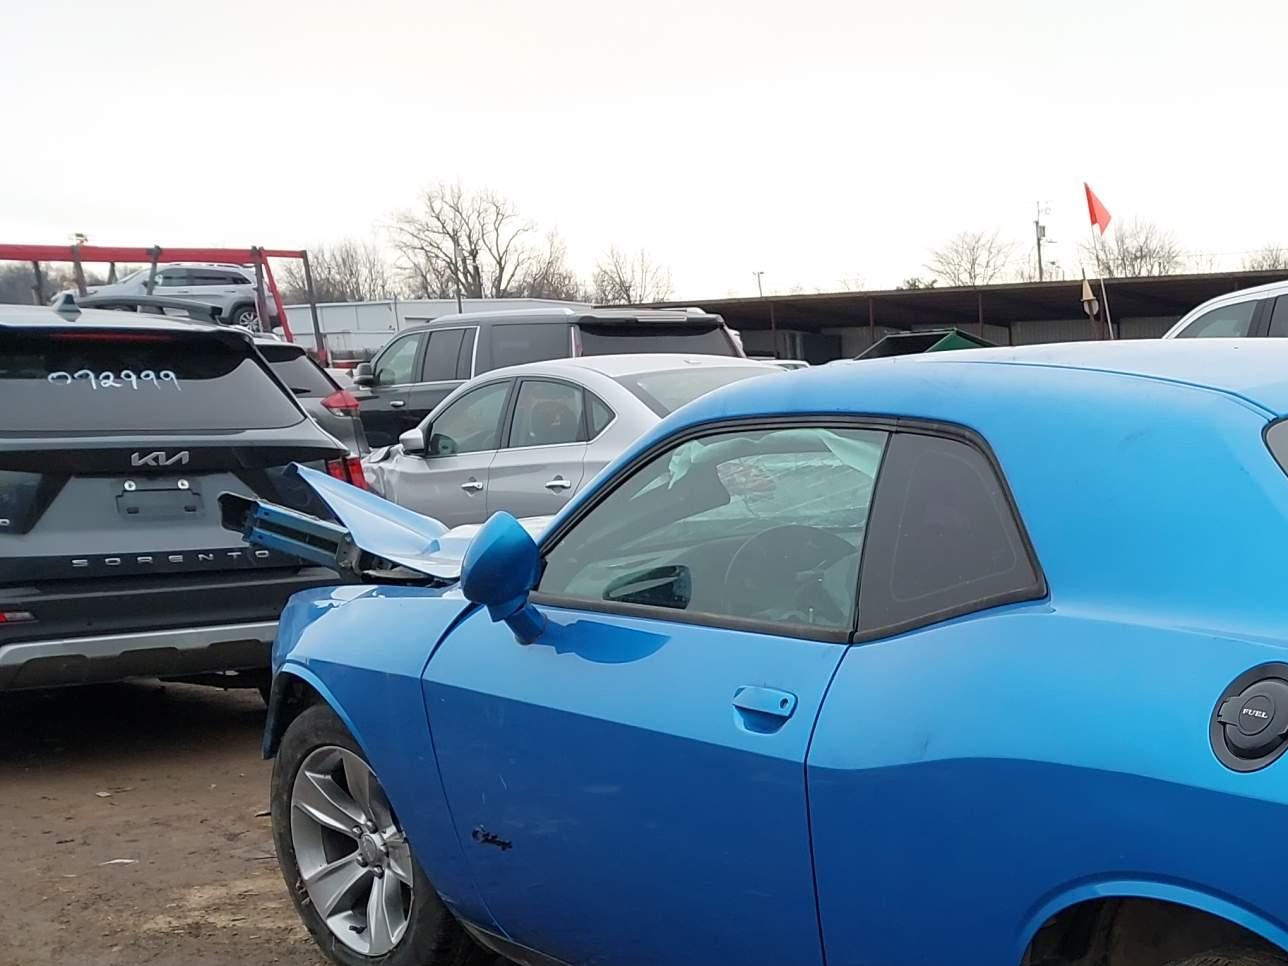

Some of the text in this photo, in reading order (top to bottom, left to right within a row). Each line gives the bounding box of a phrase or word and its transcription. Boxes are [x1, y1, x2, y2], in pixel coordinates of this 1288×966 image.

[48, 369, 181, 391] 072999
[72, 551, 270, 567] SORENTO
[1242, 708, 1268, 719] FUEL
